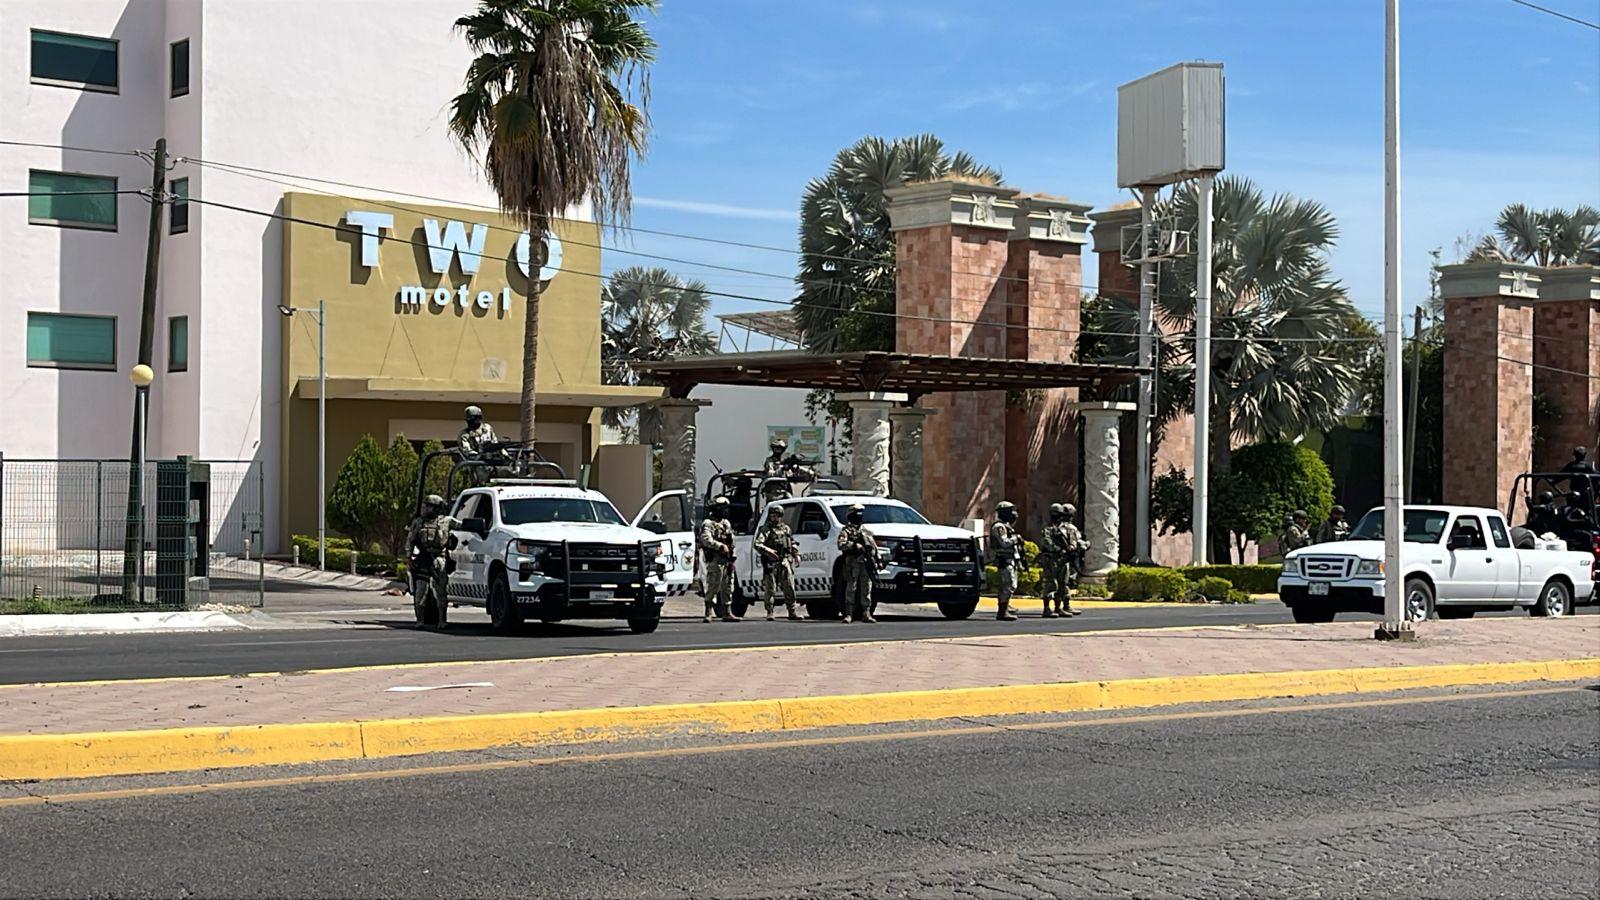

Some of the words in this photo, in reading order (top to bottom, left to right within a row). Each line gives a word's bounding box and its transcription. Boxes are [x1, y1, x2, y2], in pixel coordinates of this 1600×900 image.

[400, 283, 511, 311] motel
[799, 551, 826, 562] ACIONAL
[515, 595, 541, 604] 27234
